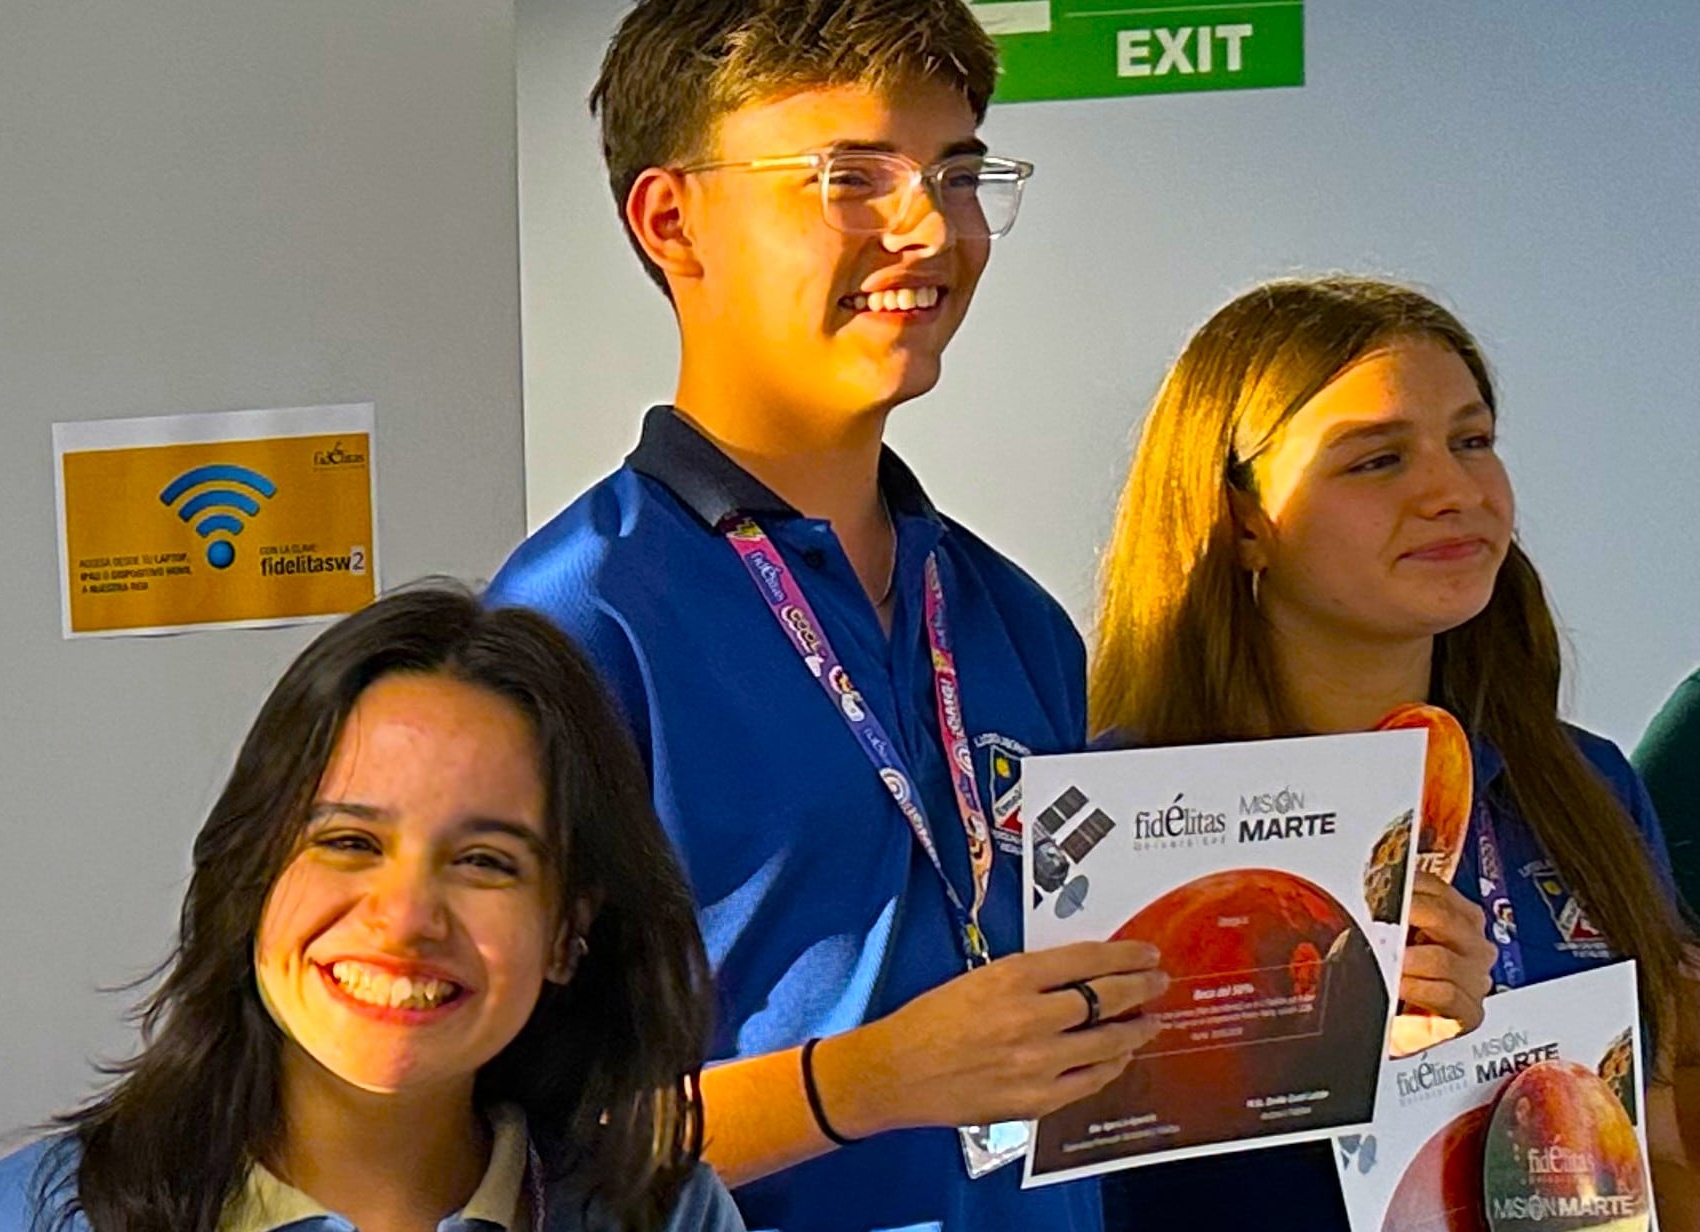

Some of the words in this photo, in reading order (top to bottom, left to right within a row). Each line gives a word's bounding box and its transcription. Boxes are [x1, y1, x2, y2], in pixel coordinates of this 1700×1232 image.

[1116, 23, 1253, 77] EXIT
[1134, 793, 1226, 839] fidélitas
[1238, 812, 1337, 843] MARTE
[1396, 1051, 1466, 1097] fidélitas
[1475, 1042, 1559, 1084] MARTE
[1558, 1194, 1636, 1217] MARTE
